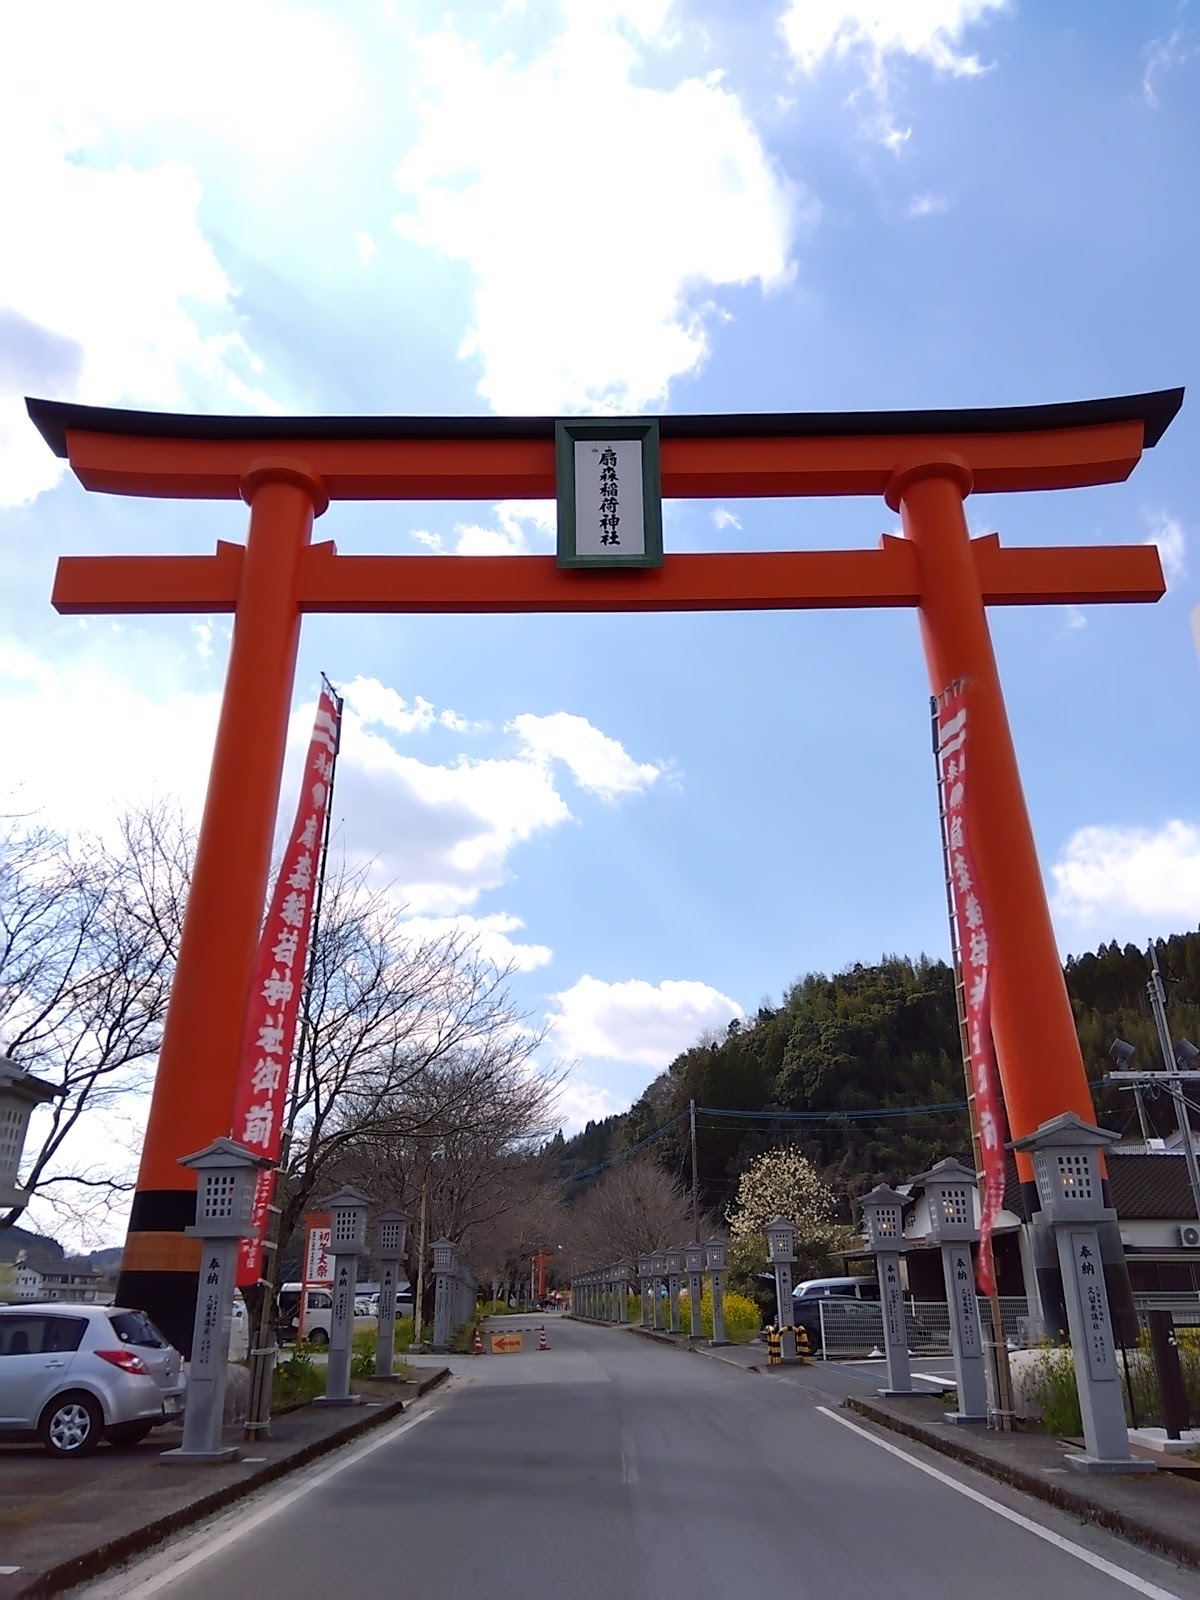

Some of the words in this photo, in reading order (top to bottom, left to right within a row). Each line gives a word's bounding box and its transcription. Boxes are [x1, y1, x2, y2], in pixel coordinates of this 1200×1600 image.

[598, 445, 621, 546] 扇森稲荷神社
[316, 1231, 331, 1278] 初午大祭
[956, 1257, 968, 1281] 奉納
[1079, 1245, 1095, 1276] 奉納
[206, 1256, 221, 1285] 奉納
[338, 1267, 348, 1287] 奉納
[887, 1264, 896, 1283] 奉納
